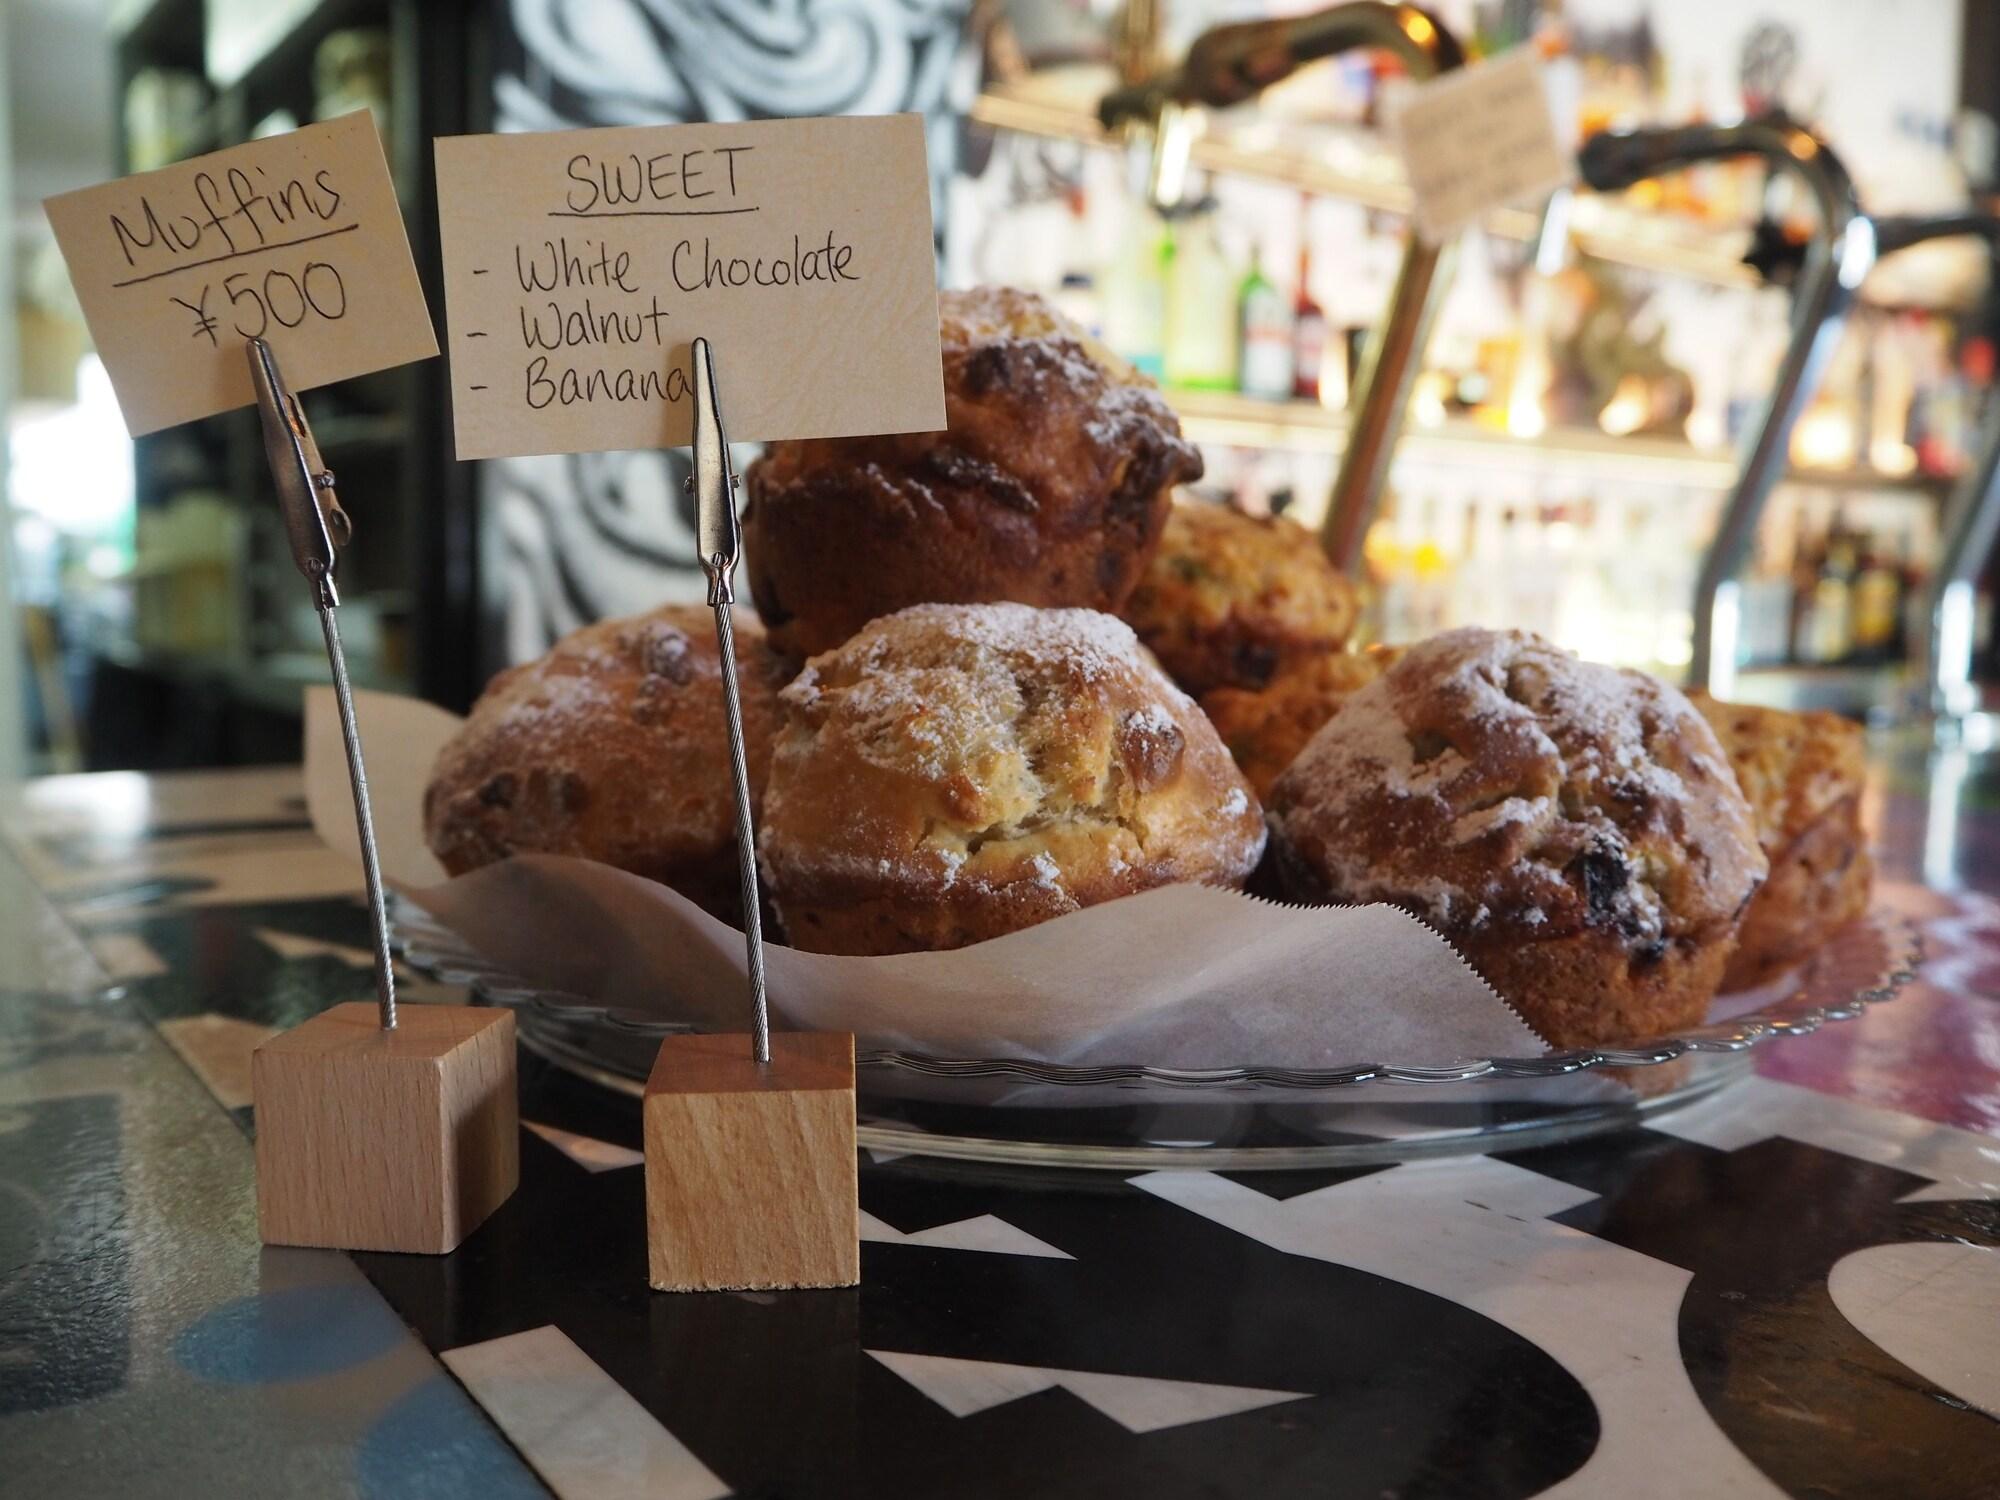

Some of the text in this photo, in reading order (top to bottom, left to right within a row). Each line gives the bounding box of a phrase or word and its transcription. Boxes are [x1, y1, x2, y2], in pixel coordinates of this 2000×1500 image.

[567, 147, 755, 211] SWEET
[110, 166, 340, 266] Muffins
[515, 237, 640, 293] White
[671, 230, 861, 292] Chocolate
[169, 262, 346, 348] ¥500
[519, 296, 669, 351] Walnut
[525, 355, 694, 409] Banana
